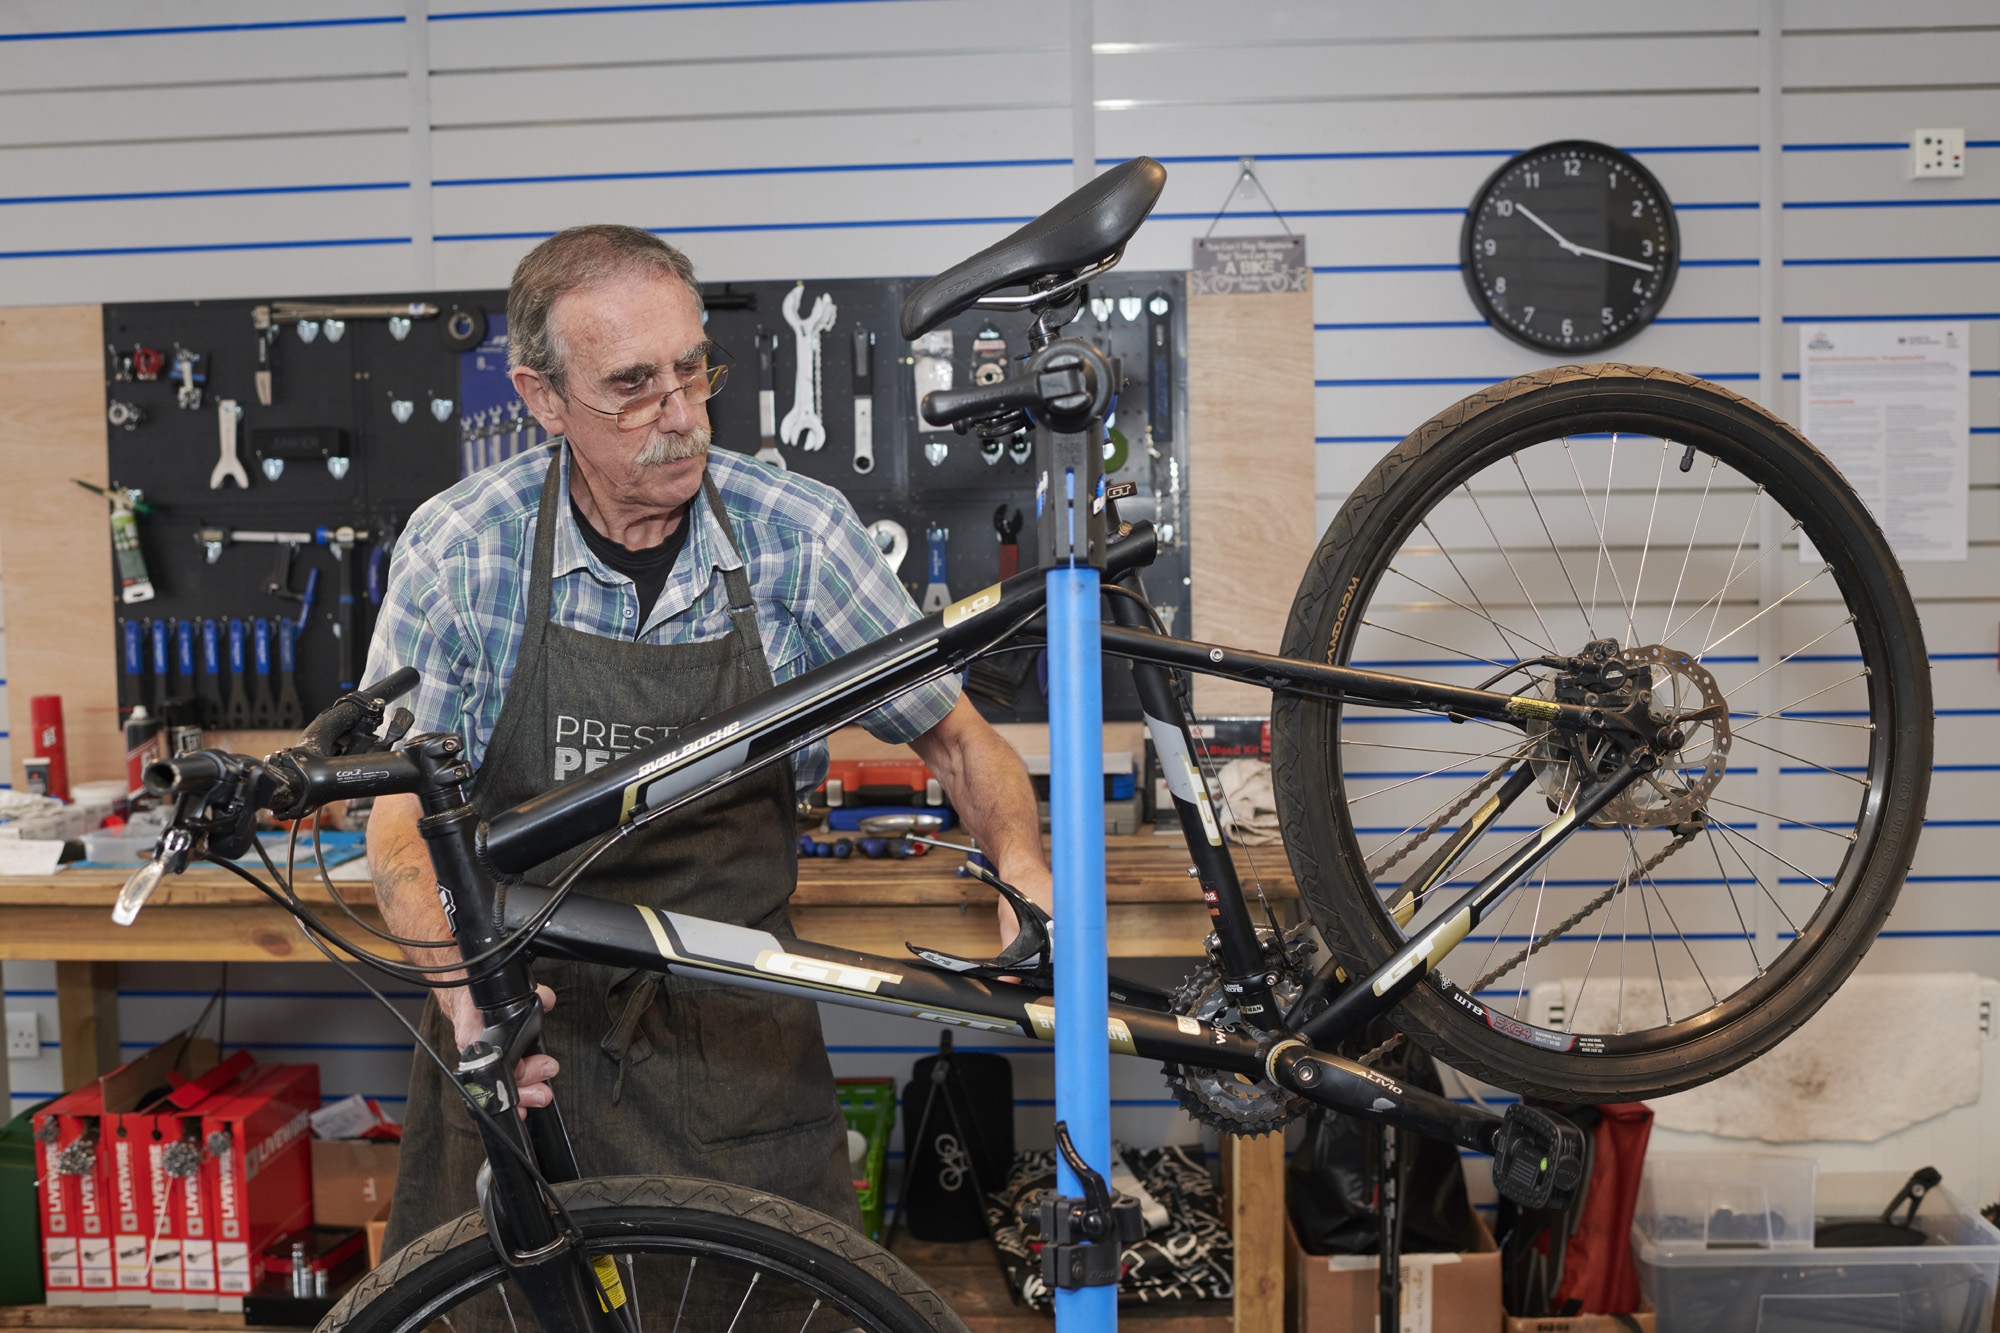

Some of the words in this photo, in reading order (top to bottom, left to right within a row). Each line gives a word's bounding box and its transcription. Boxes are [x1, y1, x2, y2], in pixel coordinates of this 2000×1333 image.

[1564, 160, 1581, 176] 12
[1524, 172, 1540, 188] 11
[1609, 173, 1617, 189] 1
[1495, 200, 1513, 216] 10
[1632, 201, 1643, 217] 2
[1485, 240, 1496, 256] 9
[1642, 240, 1653, 257] 3
[1225, 261, 1237, 275] A
[1241, 260, 1275, 275] BIKE
[1495, 277, 1506, 294] 8
[1633, 279, 1643, 295] 4
[1524, 307, 1535, 323] 7
[1602, 308, 1613, 325] 5
[1562, 319, 1573, 336] 6
[1107, 484, 1131, 498] GT
[556, 715, 707, 751] PREST
[1183, 758, 1220, 842] GT
[1377, 925, 1442, 992] GT
[762, 951, 898, 990] GT
[1453, 993, 1483, 1016] WTB
[911, 1010, 1009, 1031] GT
[1493, 1015, 1532, 1040] SX24
[1357, 1071, 1403, 1095] ALIVIO
[115, 1141, 133, 1213] LIVEWIRE
